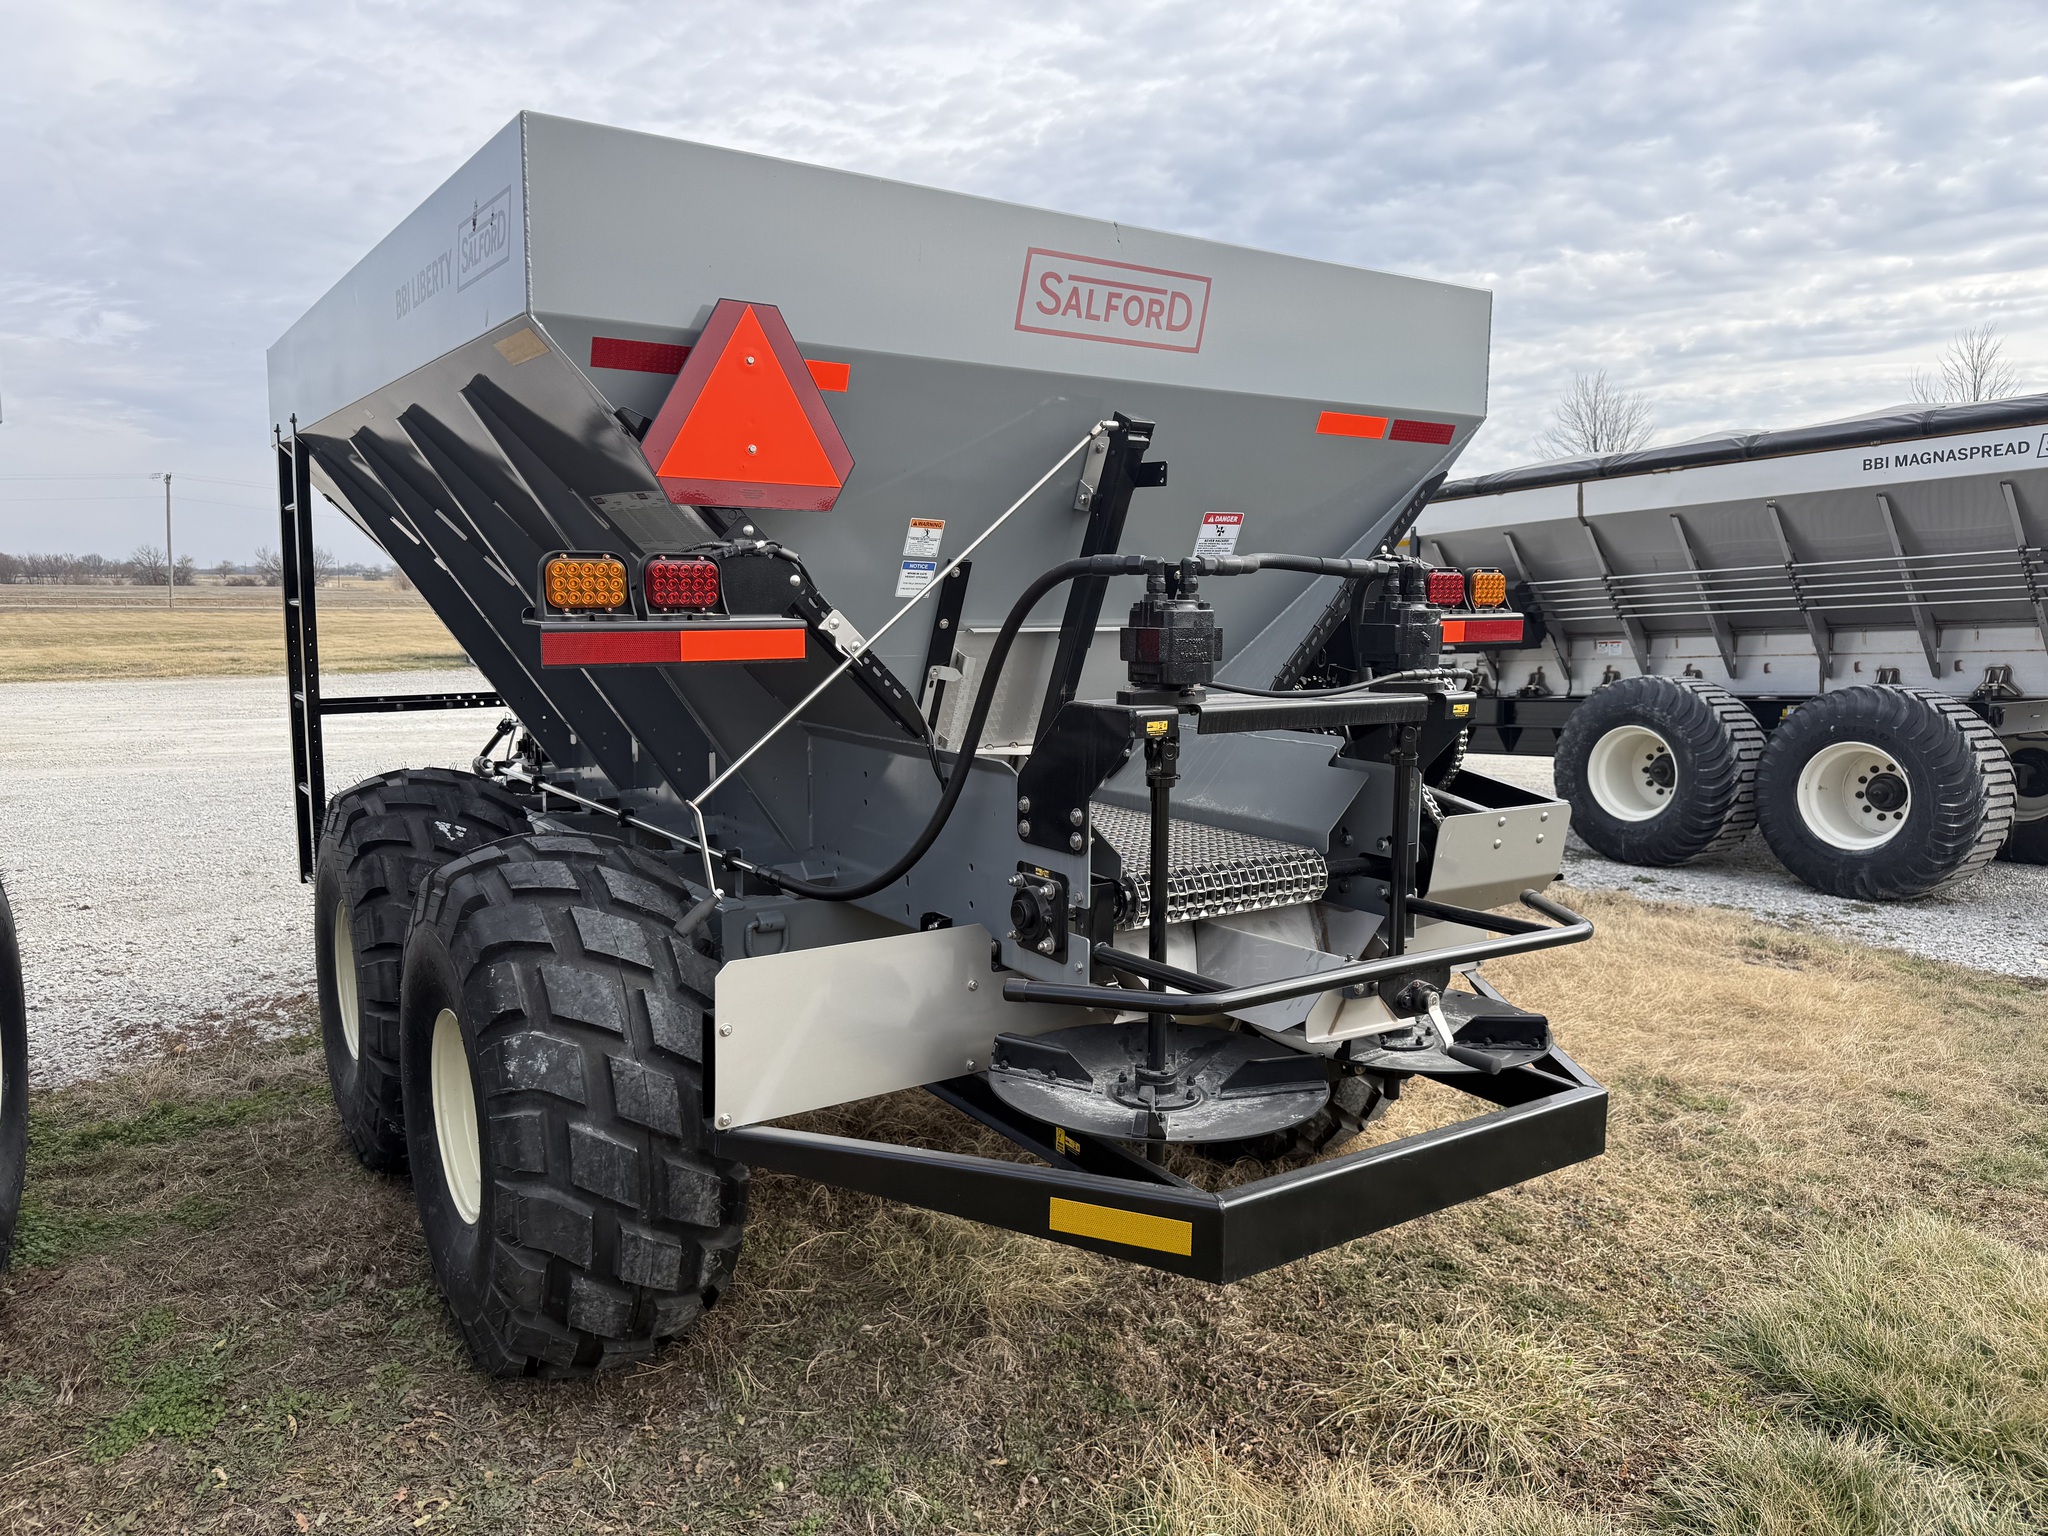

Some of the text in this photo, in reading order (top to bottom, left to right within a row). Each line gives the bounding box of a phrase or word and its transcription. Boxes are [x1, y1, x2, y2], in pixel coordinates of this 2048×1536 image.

[461, 209, 506, 274] SALFORD
[395, 248, 452, 320] BBI LIBERTY
[1036, 271, 1193, 332] SALFORD
[1862, 456, 1889, 471] BBI
[1894, 440, 2031, 468] MAGNASPREAD
